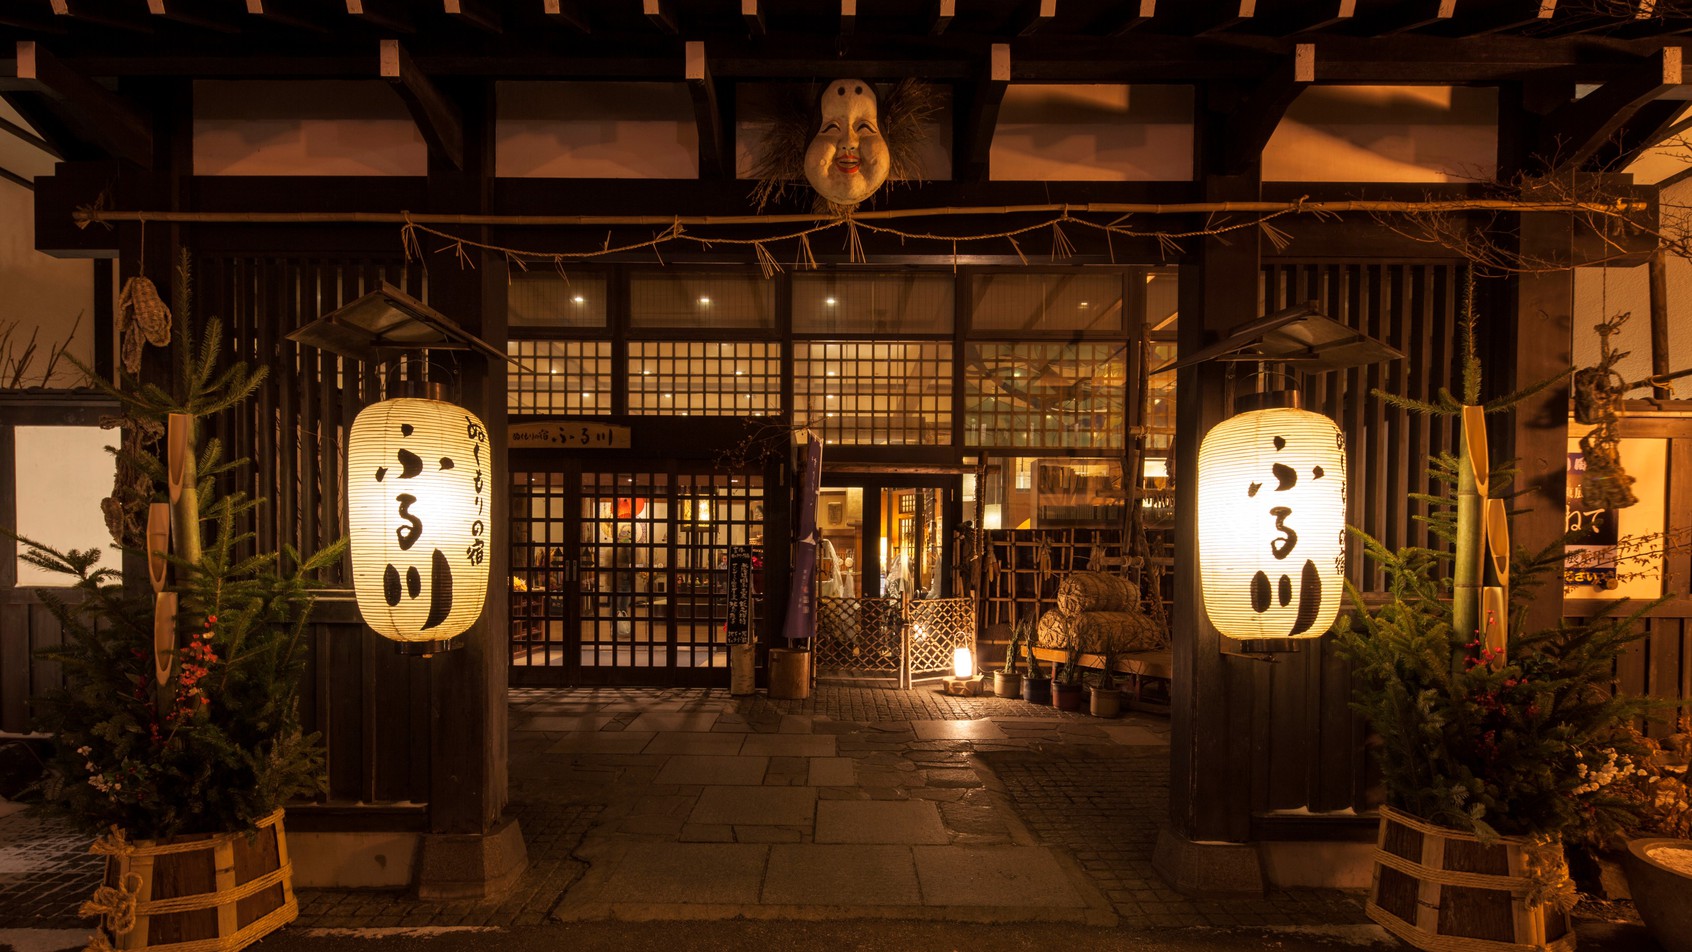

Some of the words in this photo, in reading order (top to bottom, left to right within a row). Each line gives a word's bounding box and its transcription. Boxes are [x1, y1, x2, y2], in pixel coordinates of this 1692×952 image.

[465, 416, 486, 566] ぬくもりの宿
[552, 427, 613, 446] ふる川
[376, 424, 454, 631] ふる川
[1248, 436, 1325, 636] ふる川
